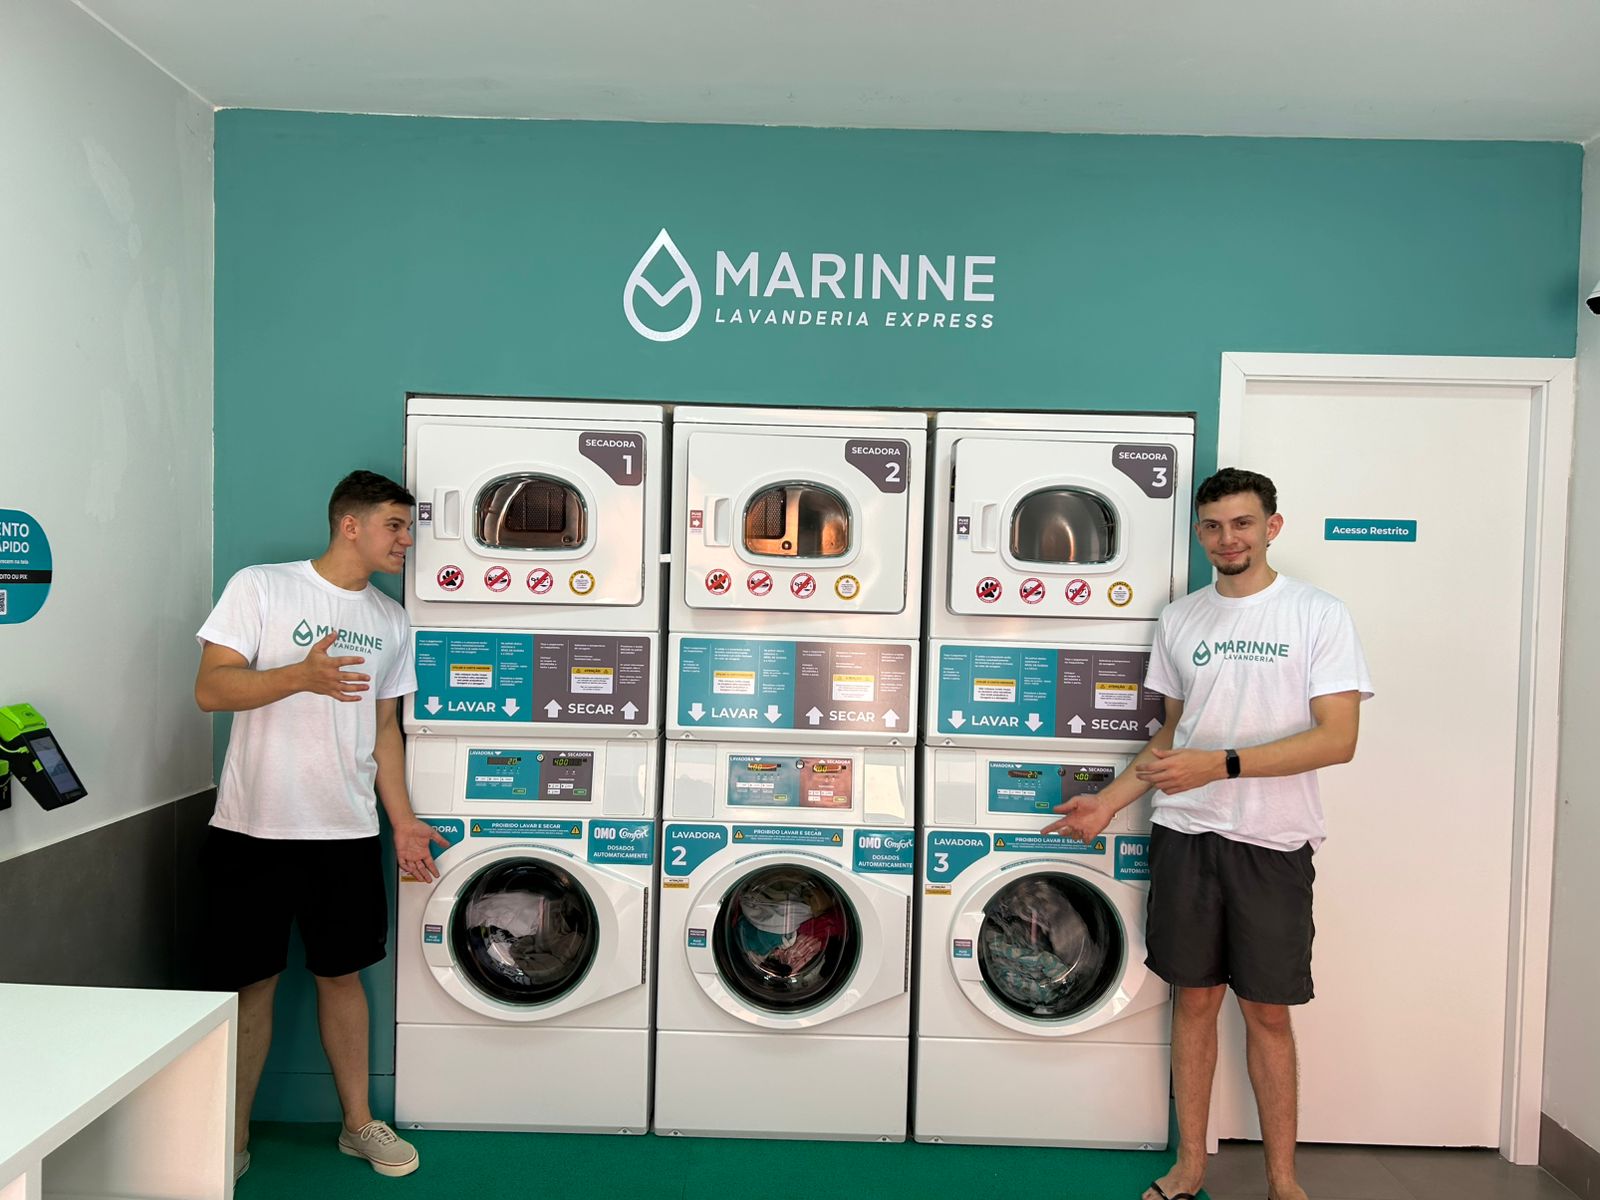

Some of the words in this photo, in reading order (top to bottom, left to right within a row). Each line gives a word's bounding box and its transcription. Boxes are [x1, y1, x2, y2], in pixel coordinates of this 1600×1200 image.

[715, 250, 996, 302] MARINNE
[714, 308, 869, 327] LAVANDERIA
[885, 312, 994, 328] EXPRESS
[585, 439, 636, 448] SECADORA
[851, 447, 901, 456] SECADORA
[1118, 452, 1168, 461] SECADORA
[622, 454, 632, 475] 1
[885, 462, 901, 482] 2
[1151, 467, 1167, 488] 3
[0, 522, 29, 537] NTO
[1332, 526, 1367, 535] Acesso
[1370, 526, 1409, 535] Restrito
[316, 625, 383, 650] MRINNE
[333, 642, 372, 655] VANDERIA
[1214, 640, 1289, 657] MARINNE
[1224, 654, 1274, 663] LAVANDERIA
[448, 701, 496, 713] LAVAR
[568, 703, 615, 715] SECAR
[711, 707, 759, 720] LAVAR
[829, 710, 876, 723] SECAR
[971, 715, 1019, 728] LAVAR
[1091, 719, 1139, 731] SECAR
[594, 827, 616, 839] OMO
[619, 825, 649, 842] Comfort
[672, 831, 721, 839] LAVADORA
[859, 837, 881, 849] OMO
[884, 837, 913, 852] Comfort
[934, 838, 983, 847] LAVADORA
[1120, 842, 1143, 855] OMO
[671, 846, 687, 866] 2
[933, 853, 949, 873] 3
